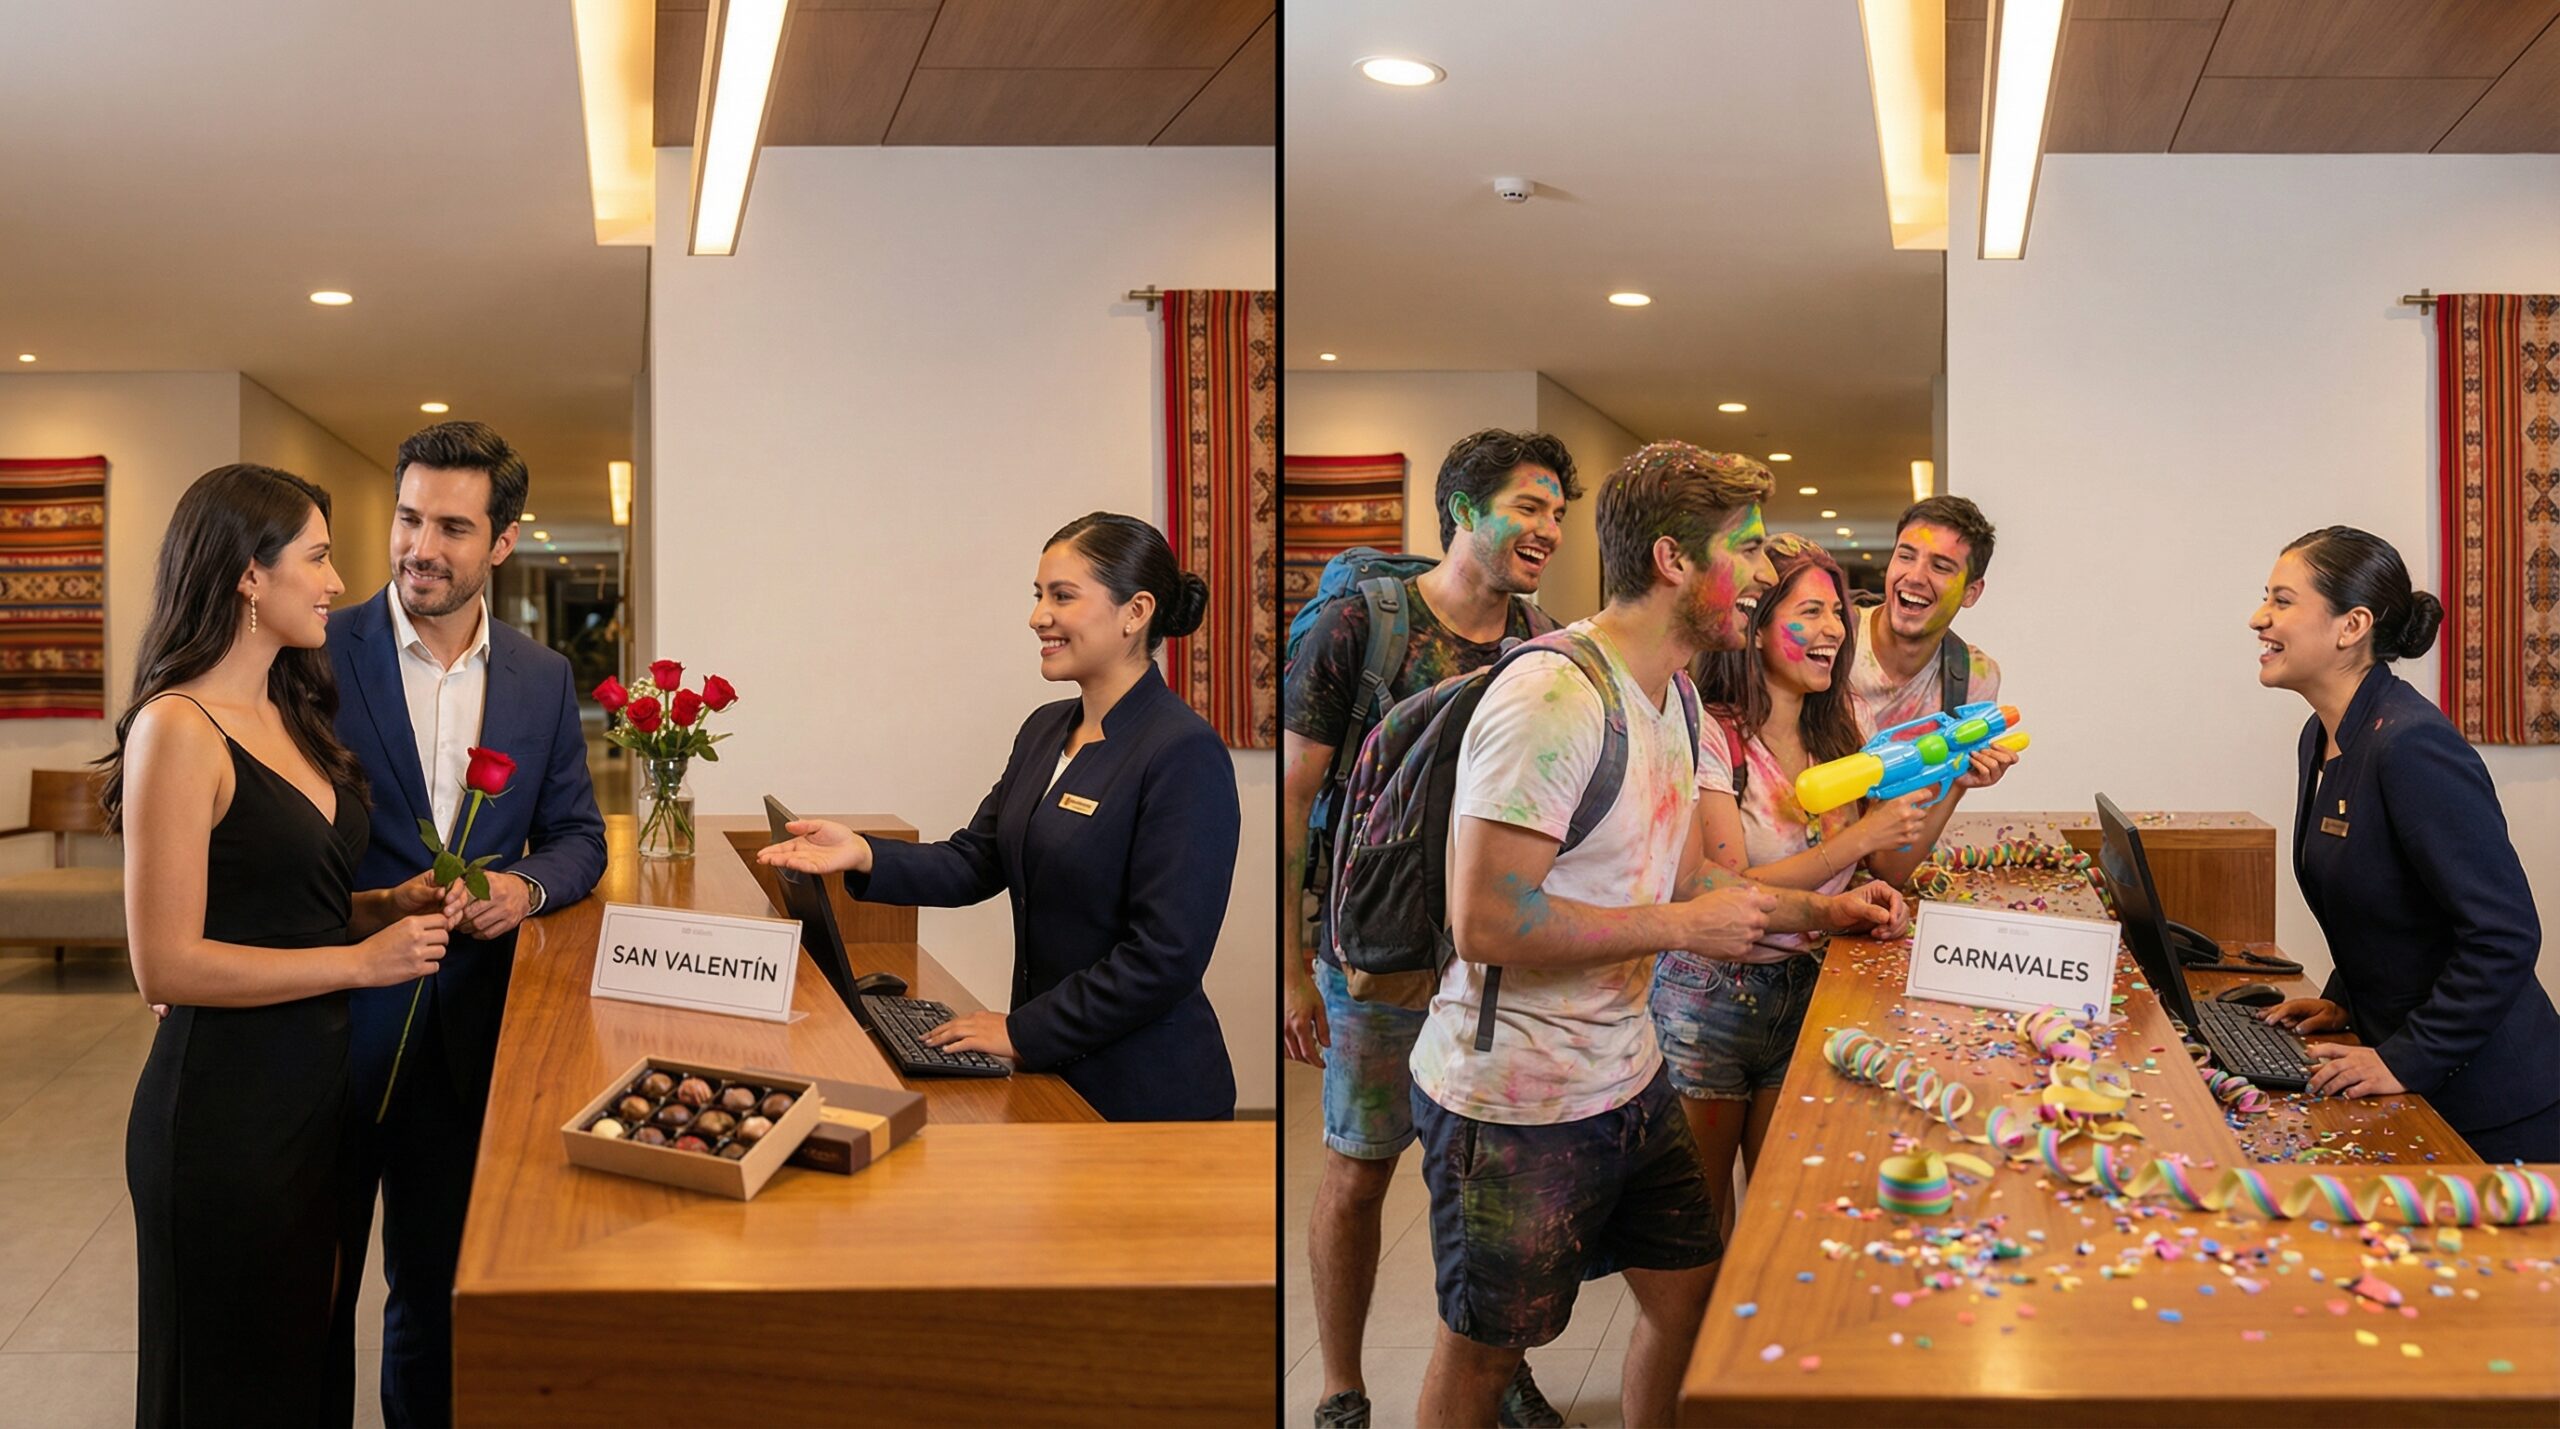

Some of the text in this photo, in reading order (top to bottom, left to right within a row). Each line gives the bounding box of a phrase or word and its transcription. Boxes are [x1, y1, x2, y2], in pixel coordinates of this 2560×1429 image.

[612, 944, 778, 982] SAN VALENTÍN
[1933, 944, 2089, 982] CARNAVALES
